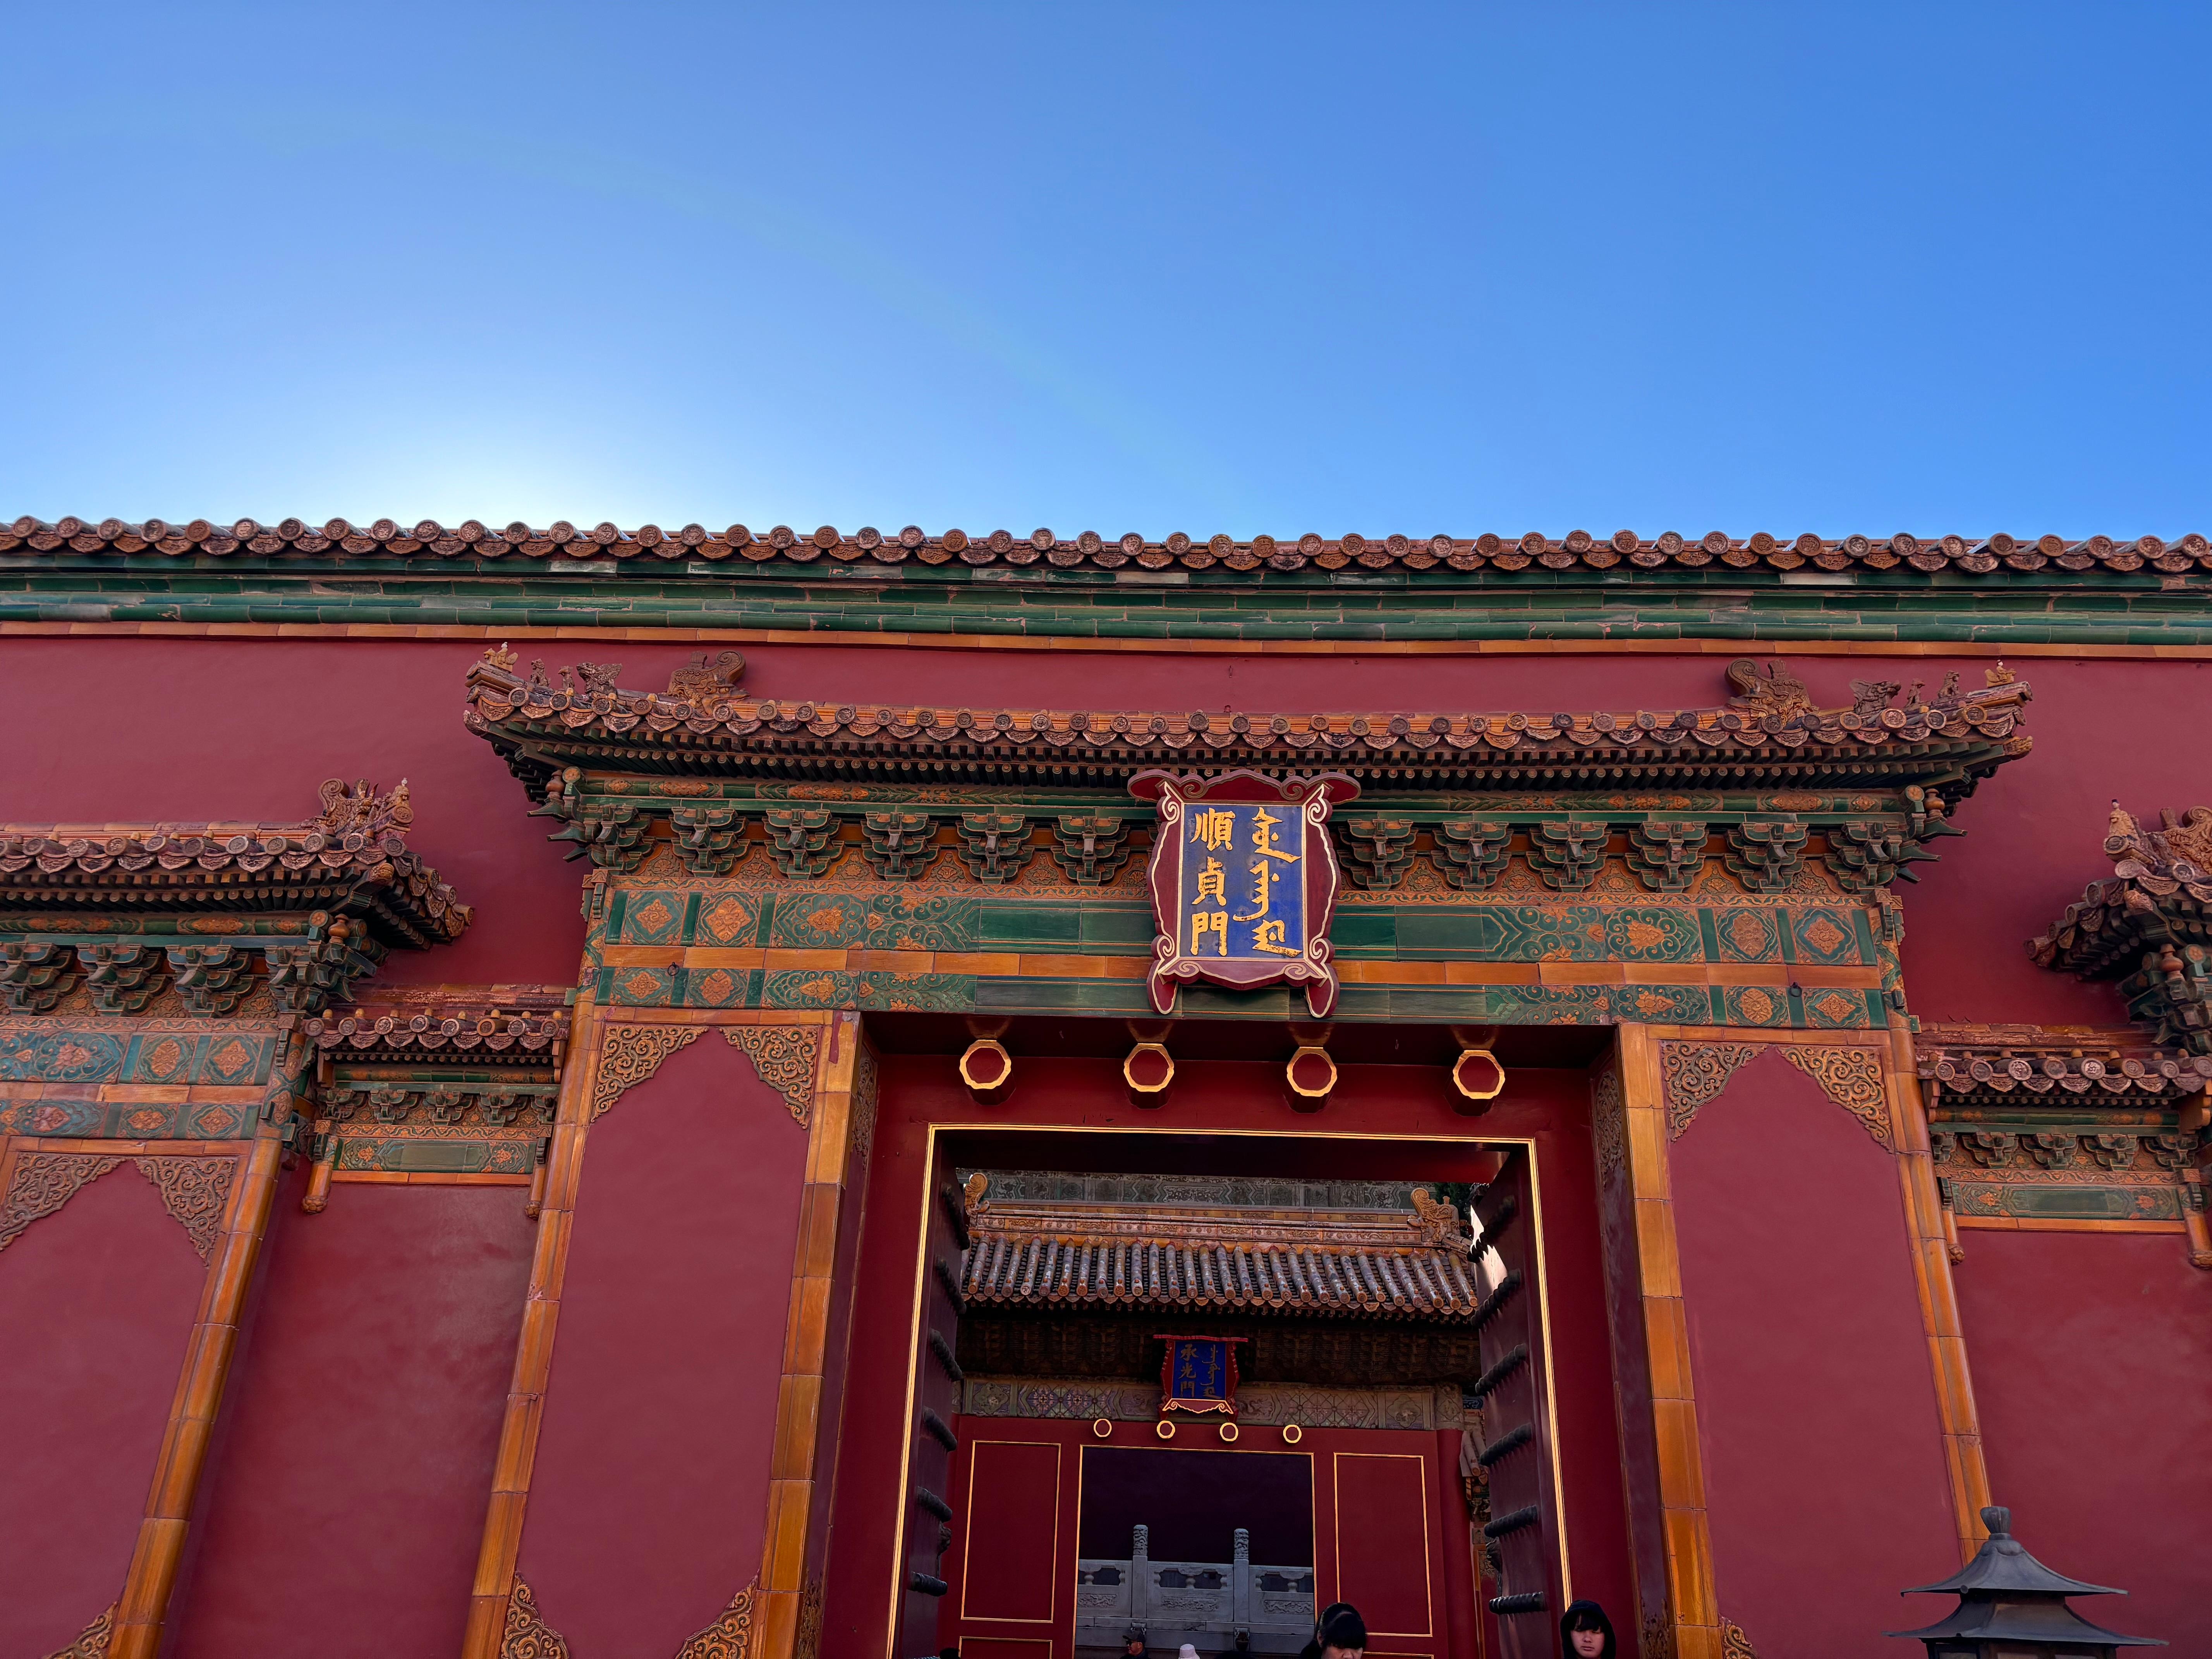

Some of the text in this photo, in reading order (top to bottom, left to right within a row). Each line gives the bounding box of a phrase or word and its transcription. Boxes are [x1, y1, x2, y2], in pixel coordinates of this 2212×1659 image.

[1190, 808, 1235, 956] 順貞門
[1178, 1343, 1199, 1398] 承光門
